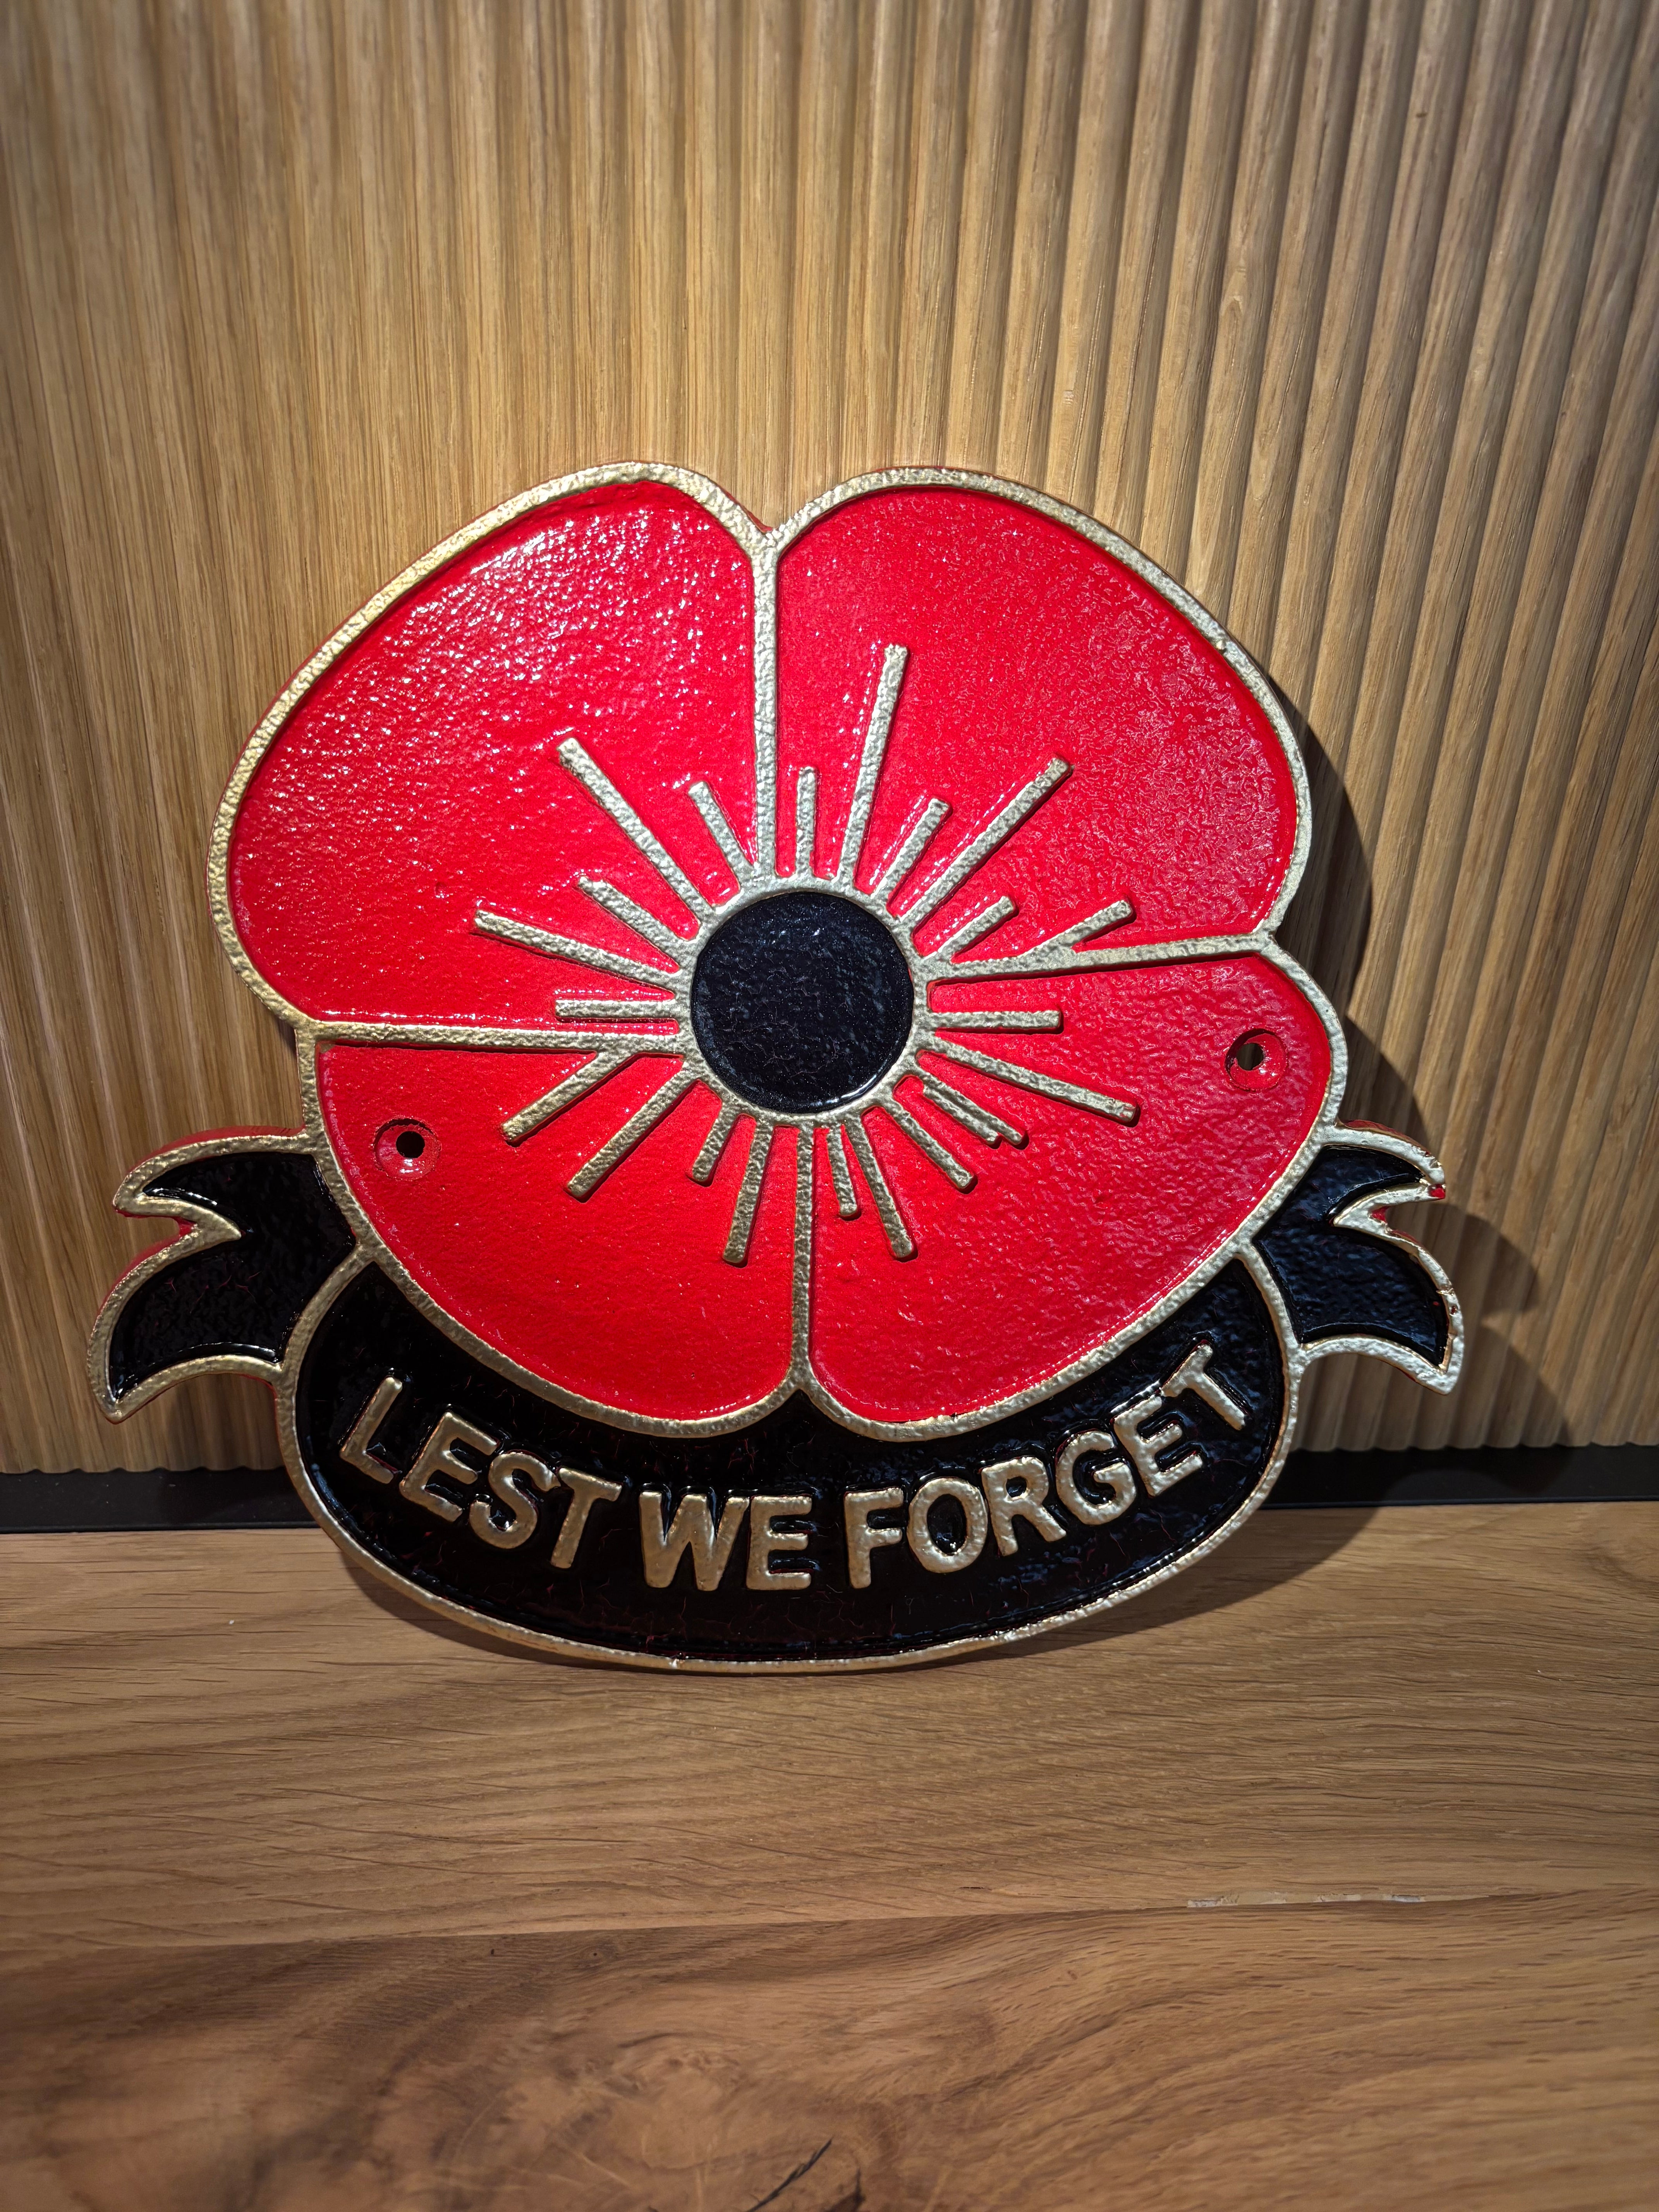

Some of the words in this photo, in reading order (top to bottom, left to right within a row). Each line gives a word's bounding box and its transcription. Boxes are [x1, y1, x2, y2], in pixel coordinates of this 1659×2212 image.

[340, 1376, 622, 1569] LEST
[639, 1492, 812, 1591] WE
[844, 1342, 1245, 1589] FORGET
